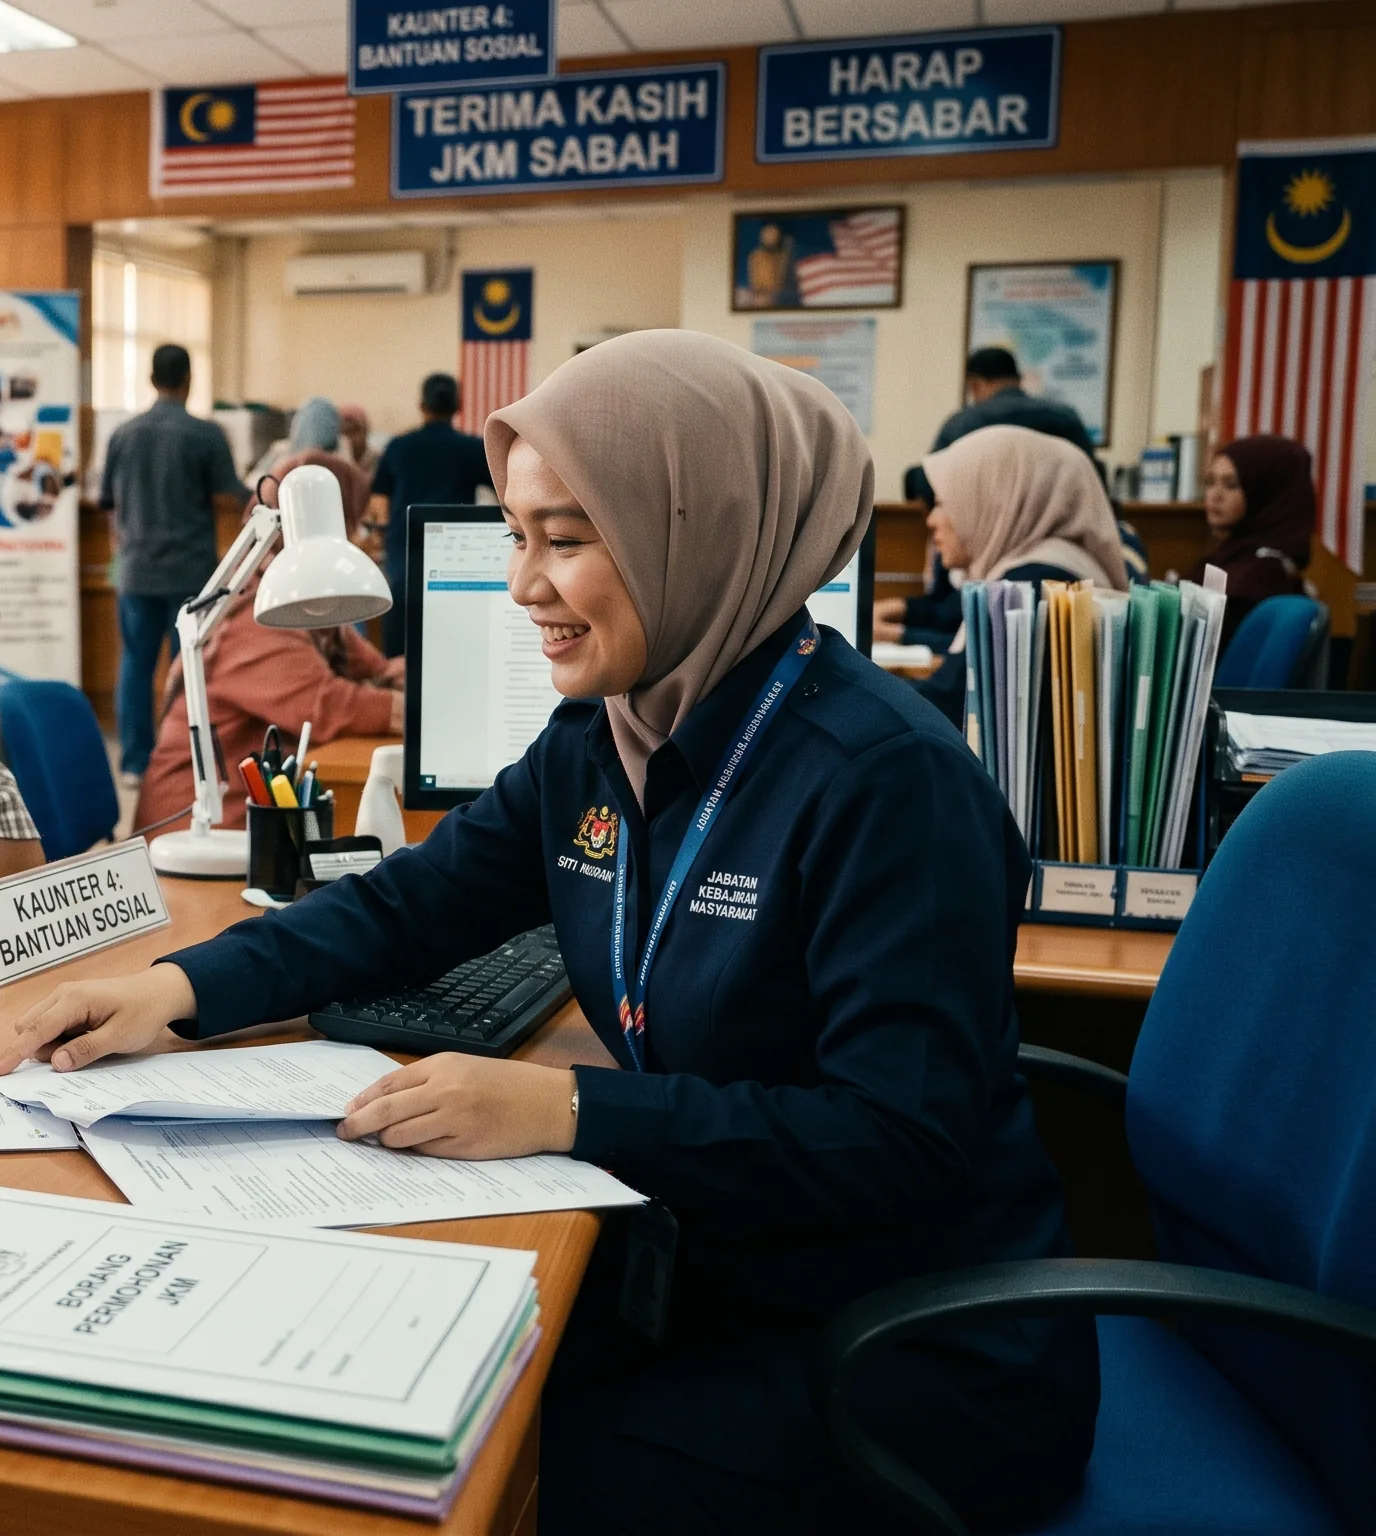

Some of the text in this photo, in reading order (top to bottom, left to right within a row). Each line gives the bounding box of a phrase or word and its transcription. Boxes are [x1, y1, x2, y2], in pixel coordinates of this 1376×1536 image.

[387, 4, 513, 37] KAUNTER 4:
[358, 32, 542, 70] BANTUAN SOSIAL
[830, 50, 983, 94] HARAP
[406, 81, 709, 137] TERIMA KASIH
[784, 95, 1028, 148] BERSABAR
[430, 131, 679, 183] JKM SABAH
[558, 855, 578, 872] SITI
[707, 870, 758, 889] JABATAN
[13, 869, 124, 922] KAUNTER 4:
[92, 891, 156, 932] SOSIAL
[689, 899, 758, 921] MASYARAKAT
[55, 1253, 132, 1308] BORANG
[73, 1240, 189, 1334] PERMOHONAN
[156, 1277, 200, 1306] JKM
